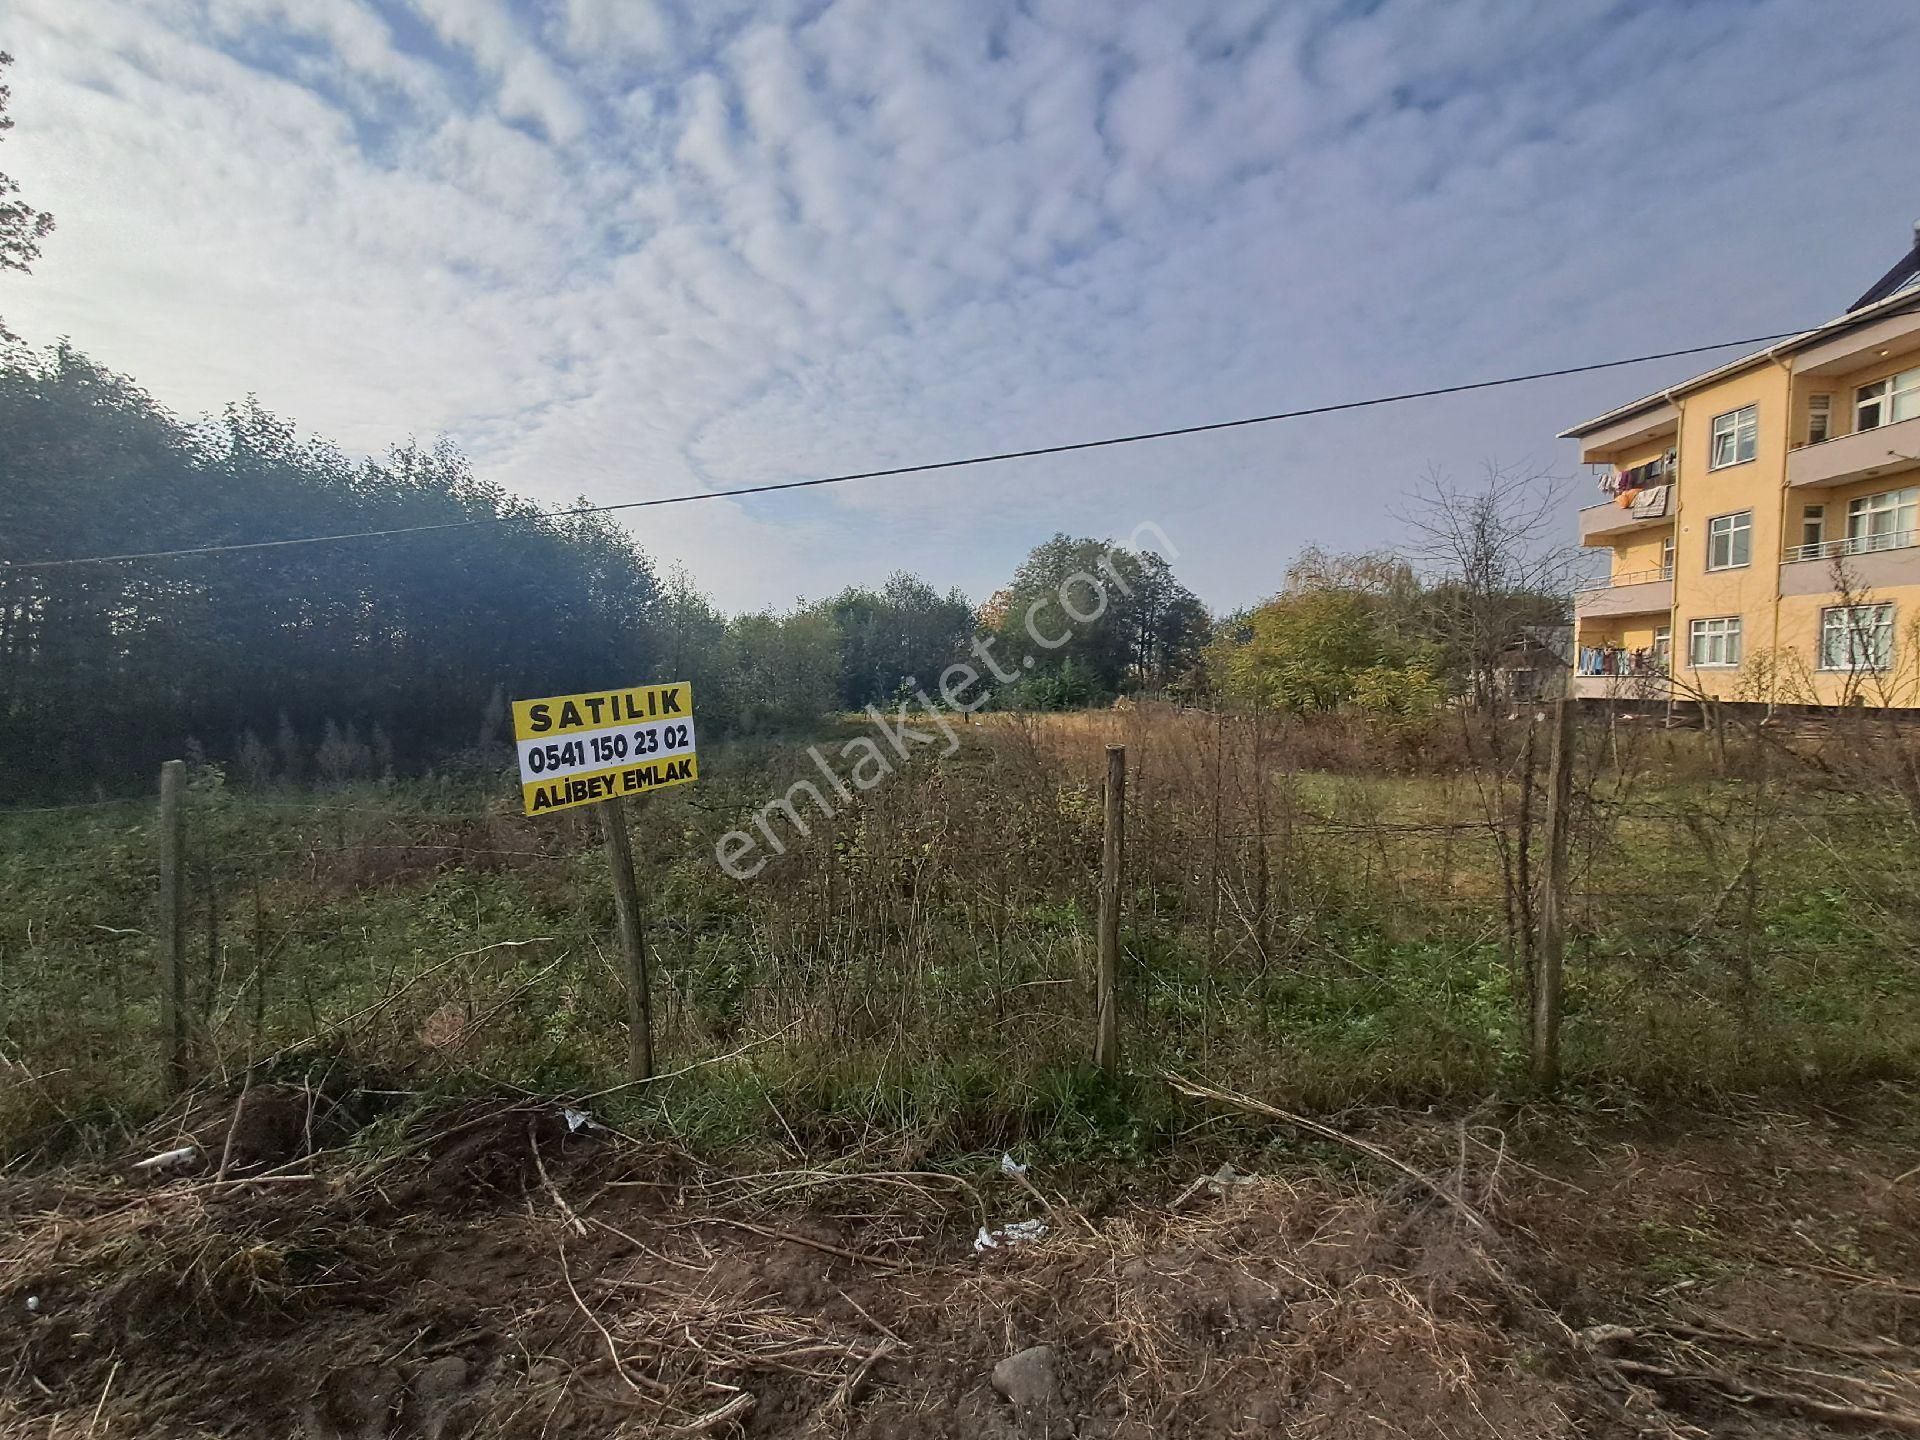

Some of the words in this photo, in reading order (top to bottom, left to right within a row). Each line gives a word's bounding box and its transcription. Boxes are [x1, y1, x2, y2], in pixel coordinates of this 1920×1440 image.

[529, 689, 681, 731] SATILIK
[529, 741, 585, 774] 0541
[590, 734, 628, 762] 150
[634, 729, 658, 755] 23
[664, 725, 688, 750] 02
[533, 774, 616, 811] ALİBEY
[623, 759, 692, 791] EMLAK
